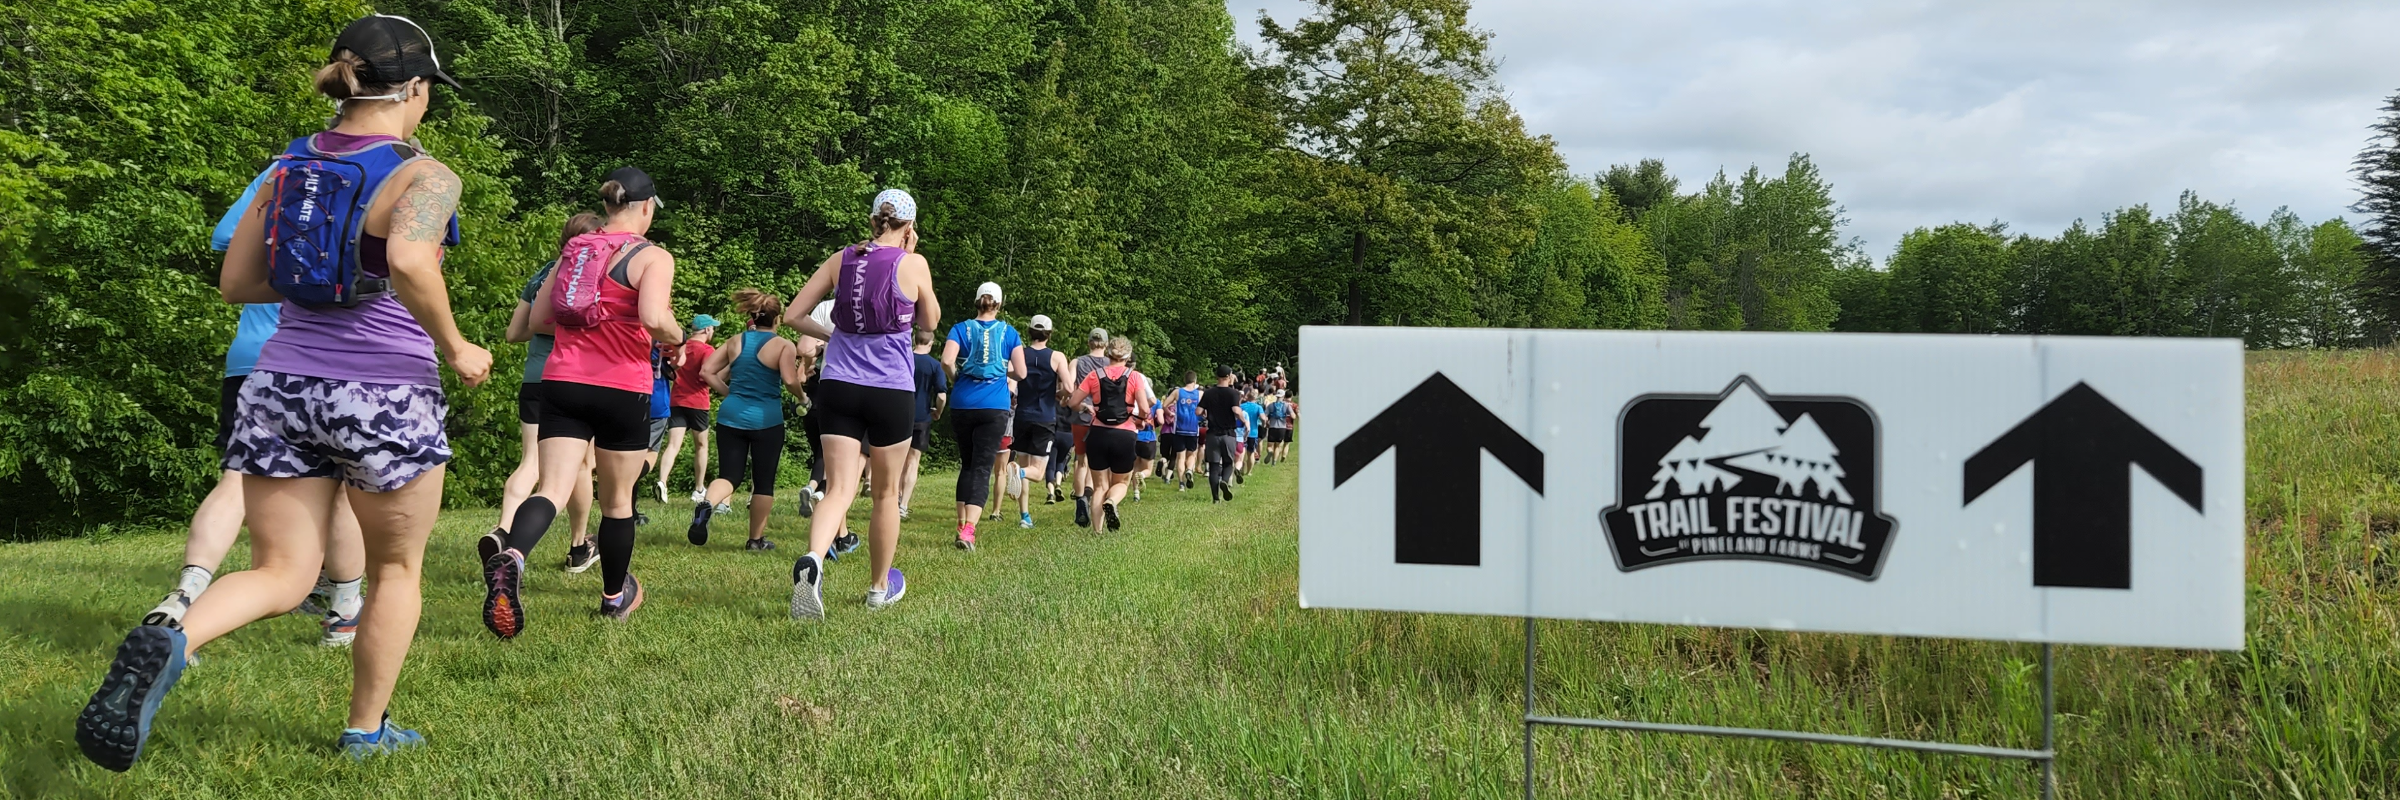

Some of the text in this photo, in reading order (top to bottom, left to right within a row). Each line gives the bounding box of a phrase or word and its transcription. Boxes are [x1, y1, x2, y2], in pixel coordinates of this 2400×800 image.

[298, 173, 320, 222] ULTIMATE
[566, 247, 589, 307] NATHAN
[852, 259, 869, 334] NATHAN
[982, 329, 990, 364] NATHAN
[1626, 496, 1867, 551] TRAIL FESTIVAL
[1691, 536, 1767, 554] PINELAND
[1769, 538, 1822, 560] FARMS
